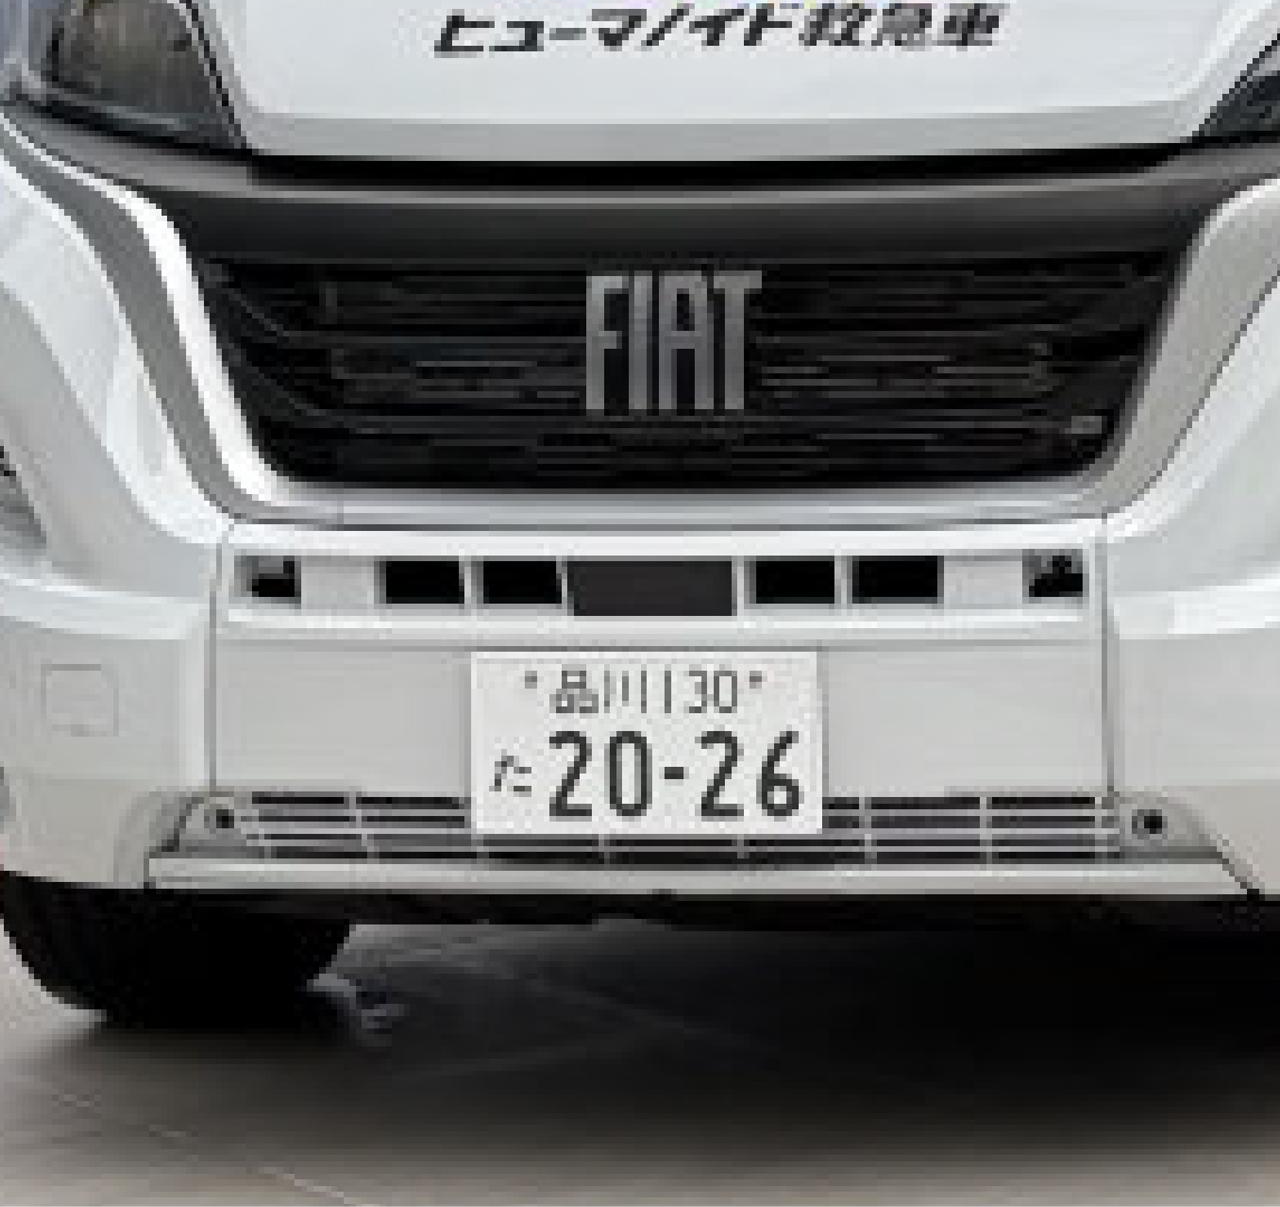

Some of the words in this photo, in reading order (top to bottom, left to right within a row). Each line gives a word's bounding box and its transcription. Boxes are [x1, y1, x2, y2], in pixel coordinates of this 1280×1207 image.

[434, 1, 1004, 56] ヒューマノイド救急車
[586, 270, 763, 410] FIAT
[549, 730, 803, 820] 20-26
